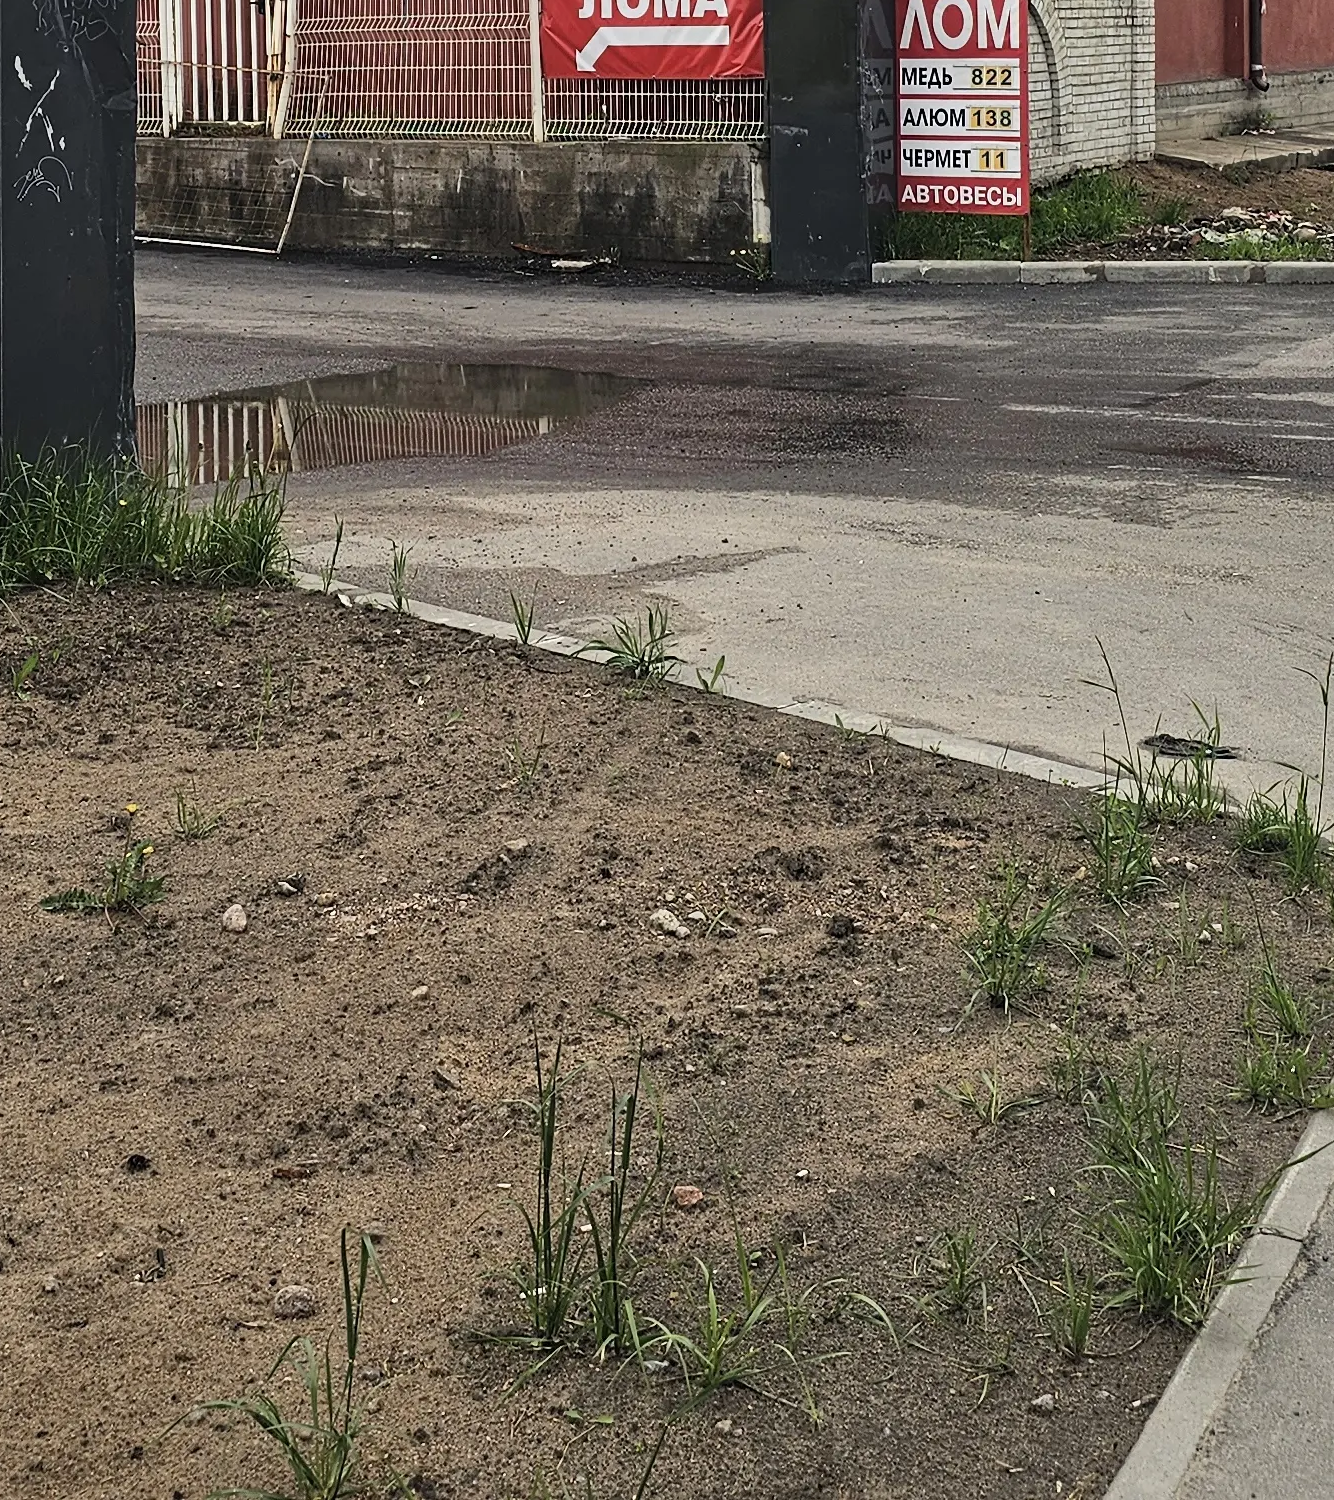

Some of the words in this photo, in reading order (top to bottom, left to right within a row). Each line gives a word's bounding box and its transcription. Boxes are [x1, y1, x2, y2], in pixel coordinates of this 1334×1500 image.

[901, 67, 953, 90] МЕДЬ
[971, 68, 1013, 86] 822
[902, 107, 966, 127] АЛЮМ
[972, 109, 1012, 127] 138
[902, 148, 972, 169] ЧЕРМЕТ
[981, 150, 1005, 169] 11
[901, 184, 1022, 207] АВТОВЕСЫ
